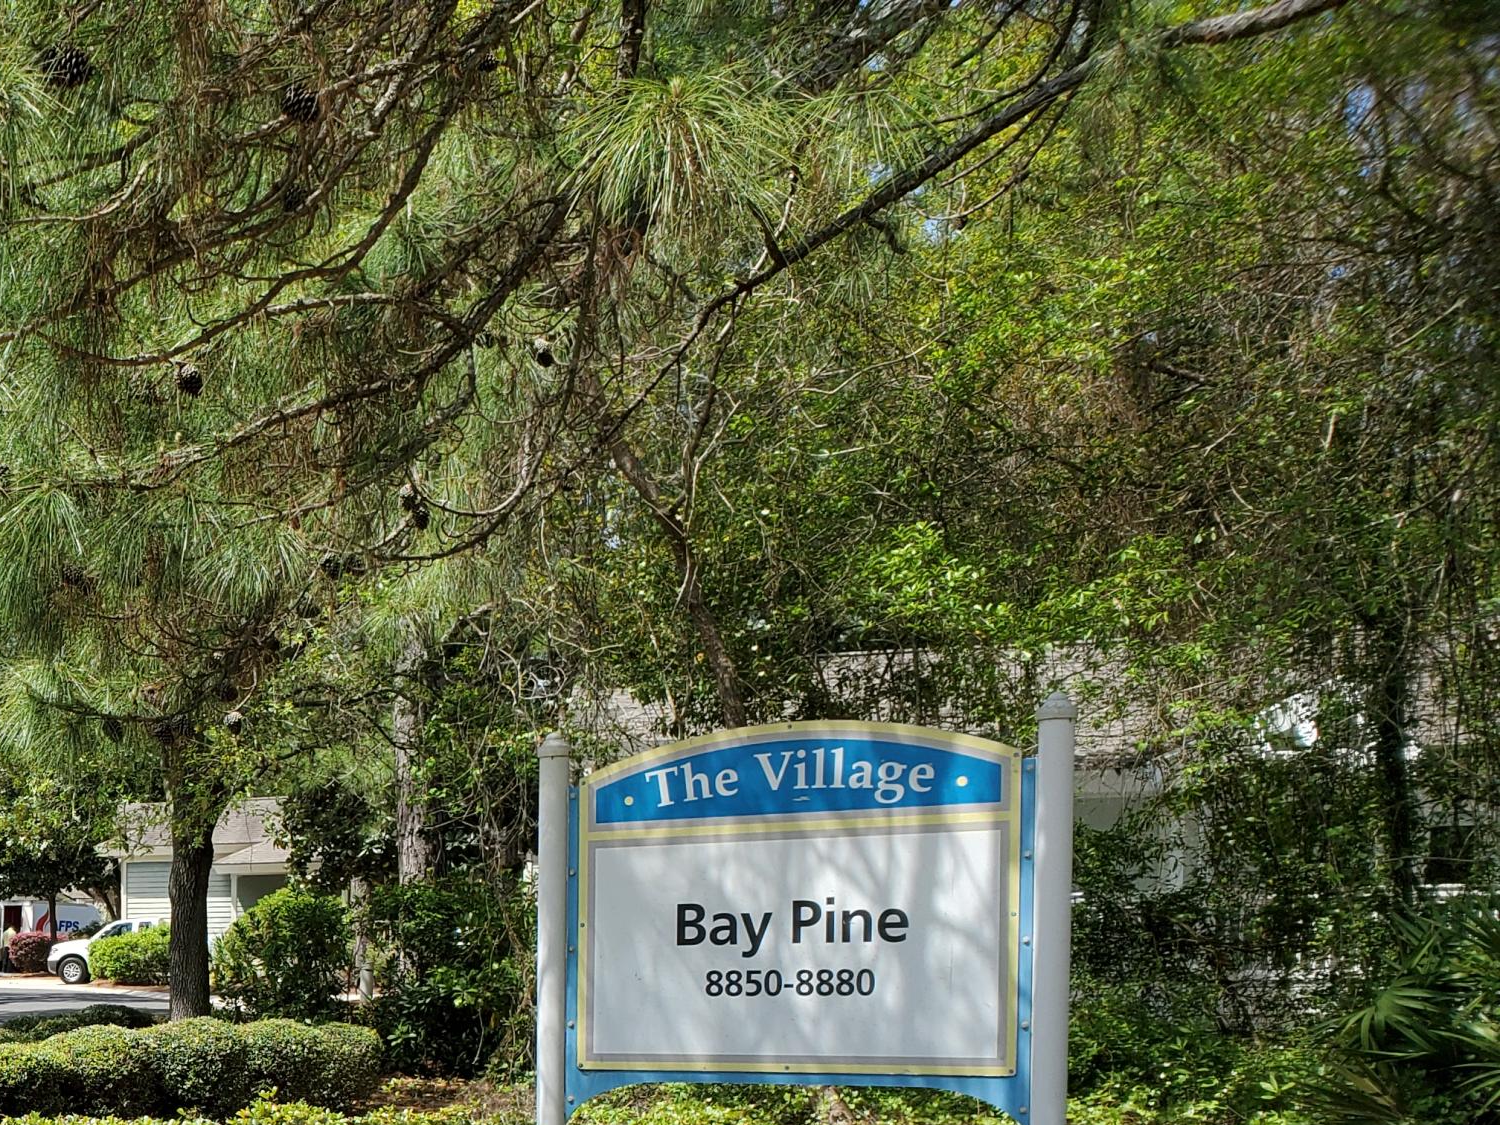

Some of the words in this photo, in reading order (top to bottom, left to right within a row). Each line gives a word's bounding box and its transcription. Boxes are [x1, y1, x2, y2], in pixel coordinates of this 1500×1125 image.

[644, 761, 739, 808] The
[752, 746, 936, 804] Village
[676, 903, 773, 958] Bay
[791, 896, 910, 944] Pine
[705, 968, 876, 997] 8850-8880
